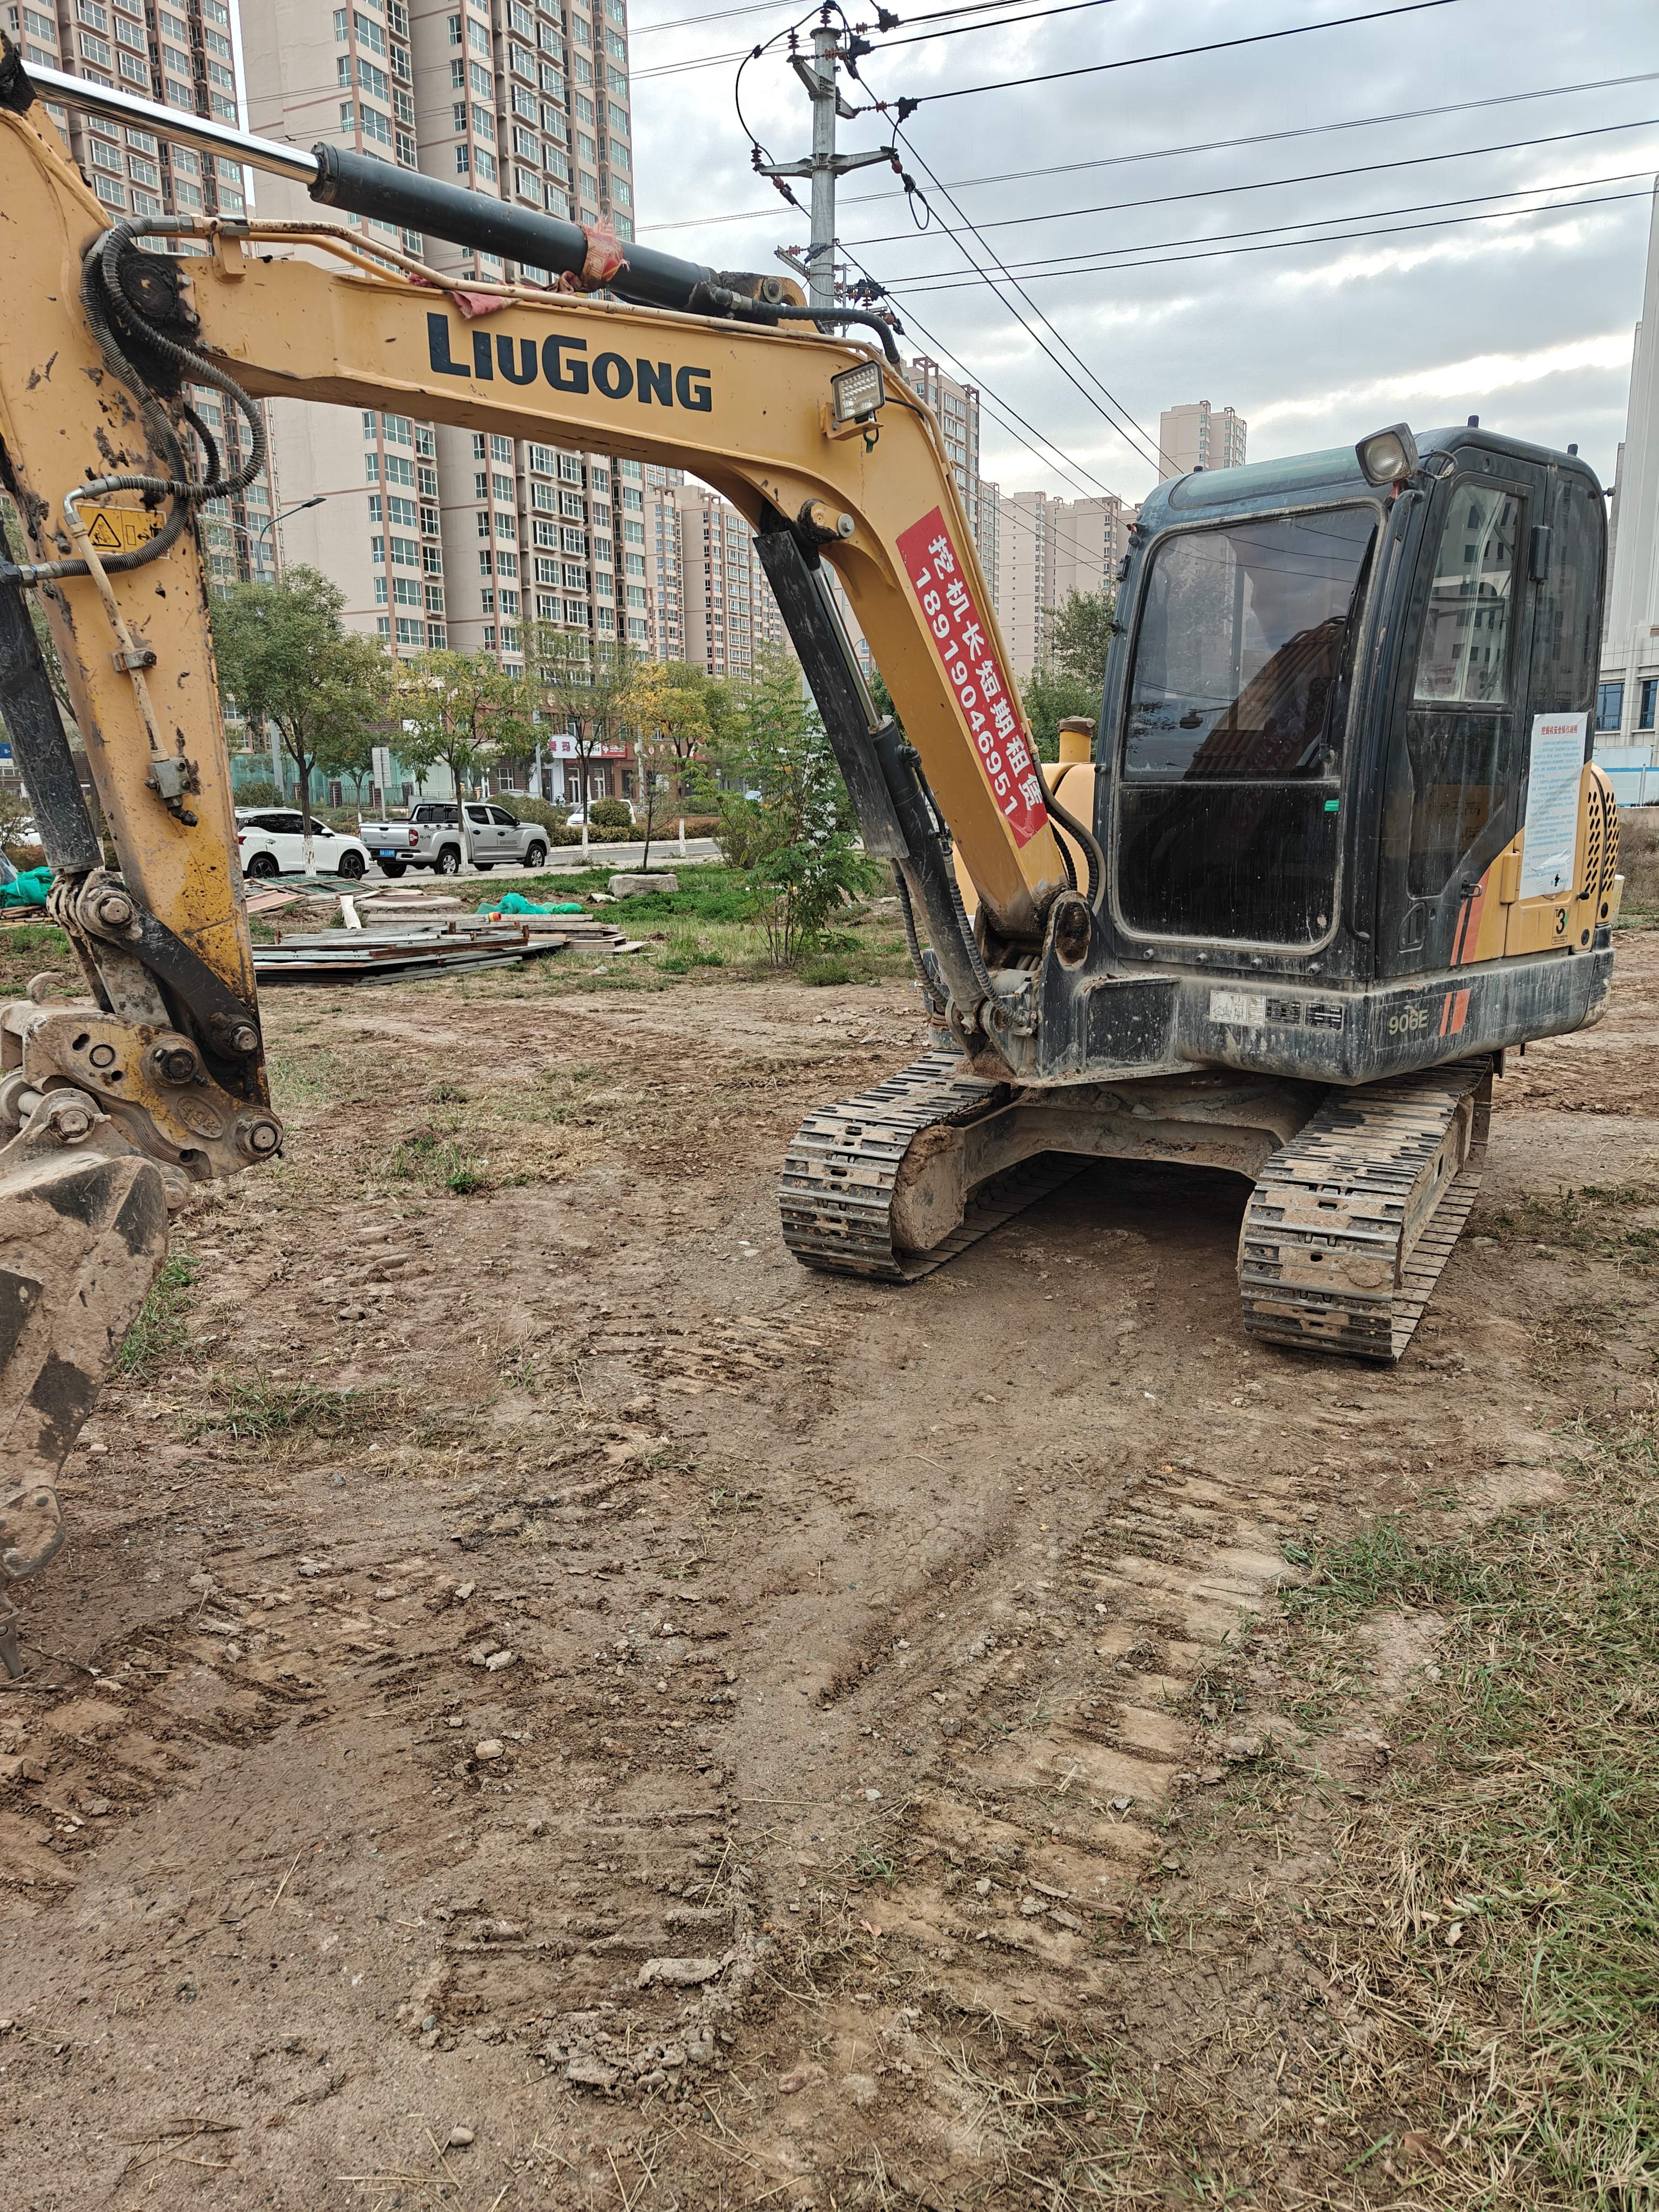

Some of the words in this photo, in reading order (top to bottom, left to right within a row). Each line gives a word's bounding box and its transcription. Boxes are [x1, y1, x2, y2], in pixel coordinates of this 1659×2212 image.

[915, 567, 1019, 816] 18919046951
[928, 534, 1044, 812] 挖机长短期租赁
[1388, 1009, 1428, 1035] 906E
